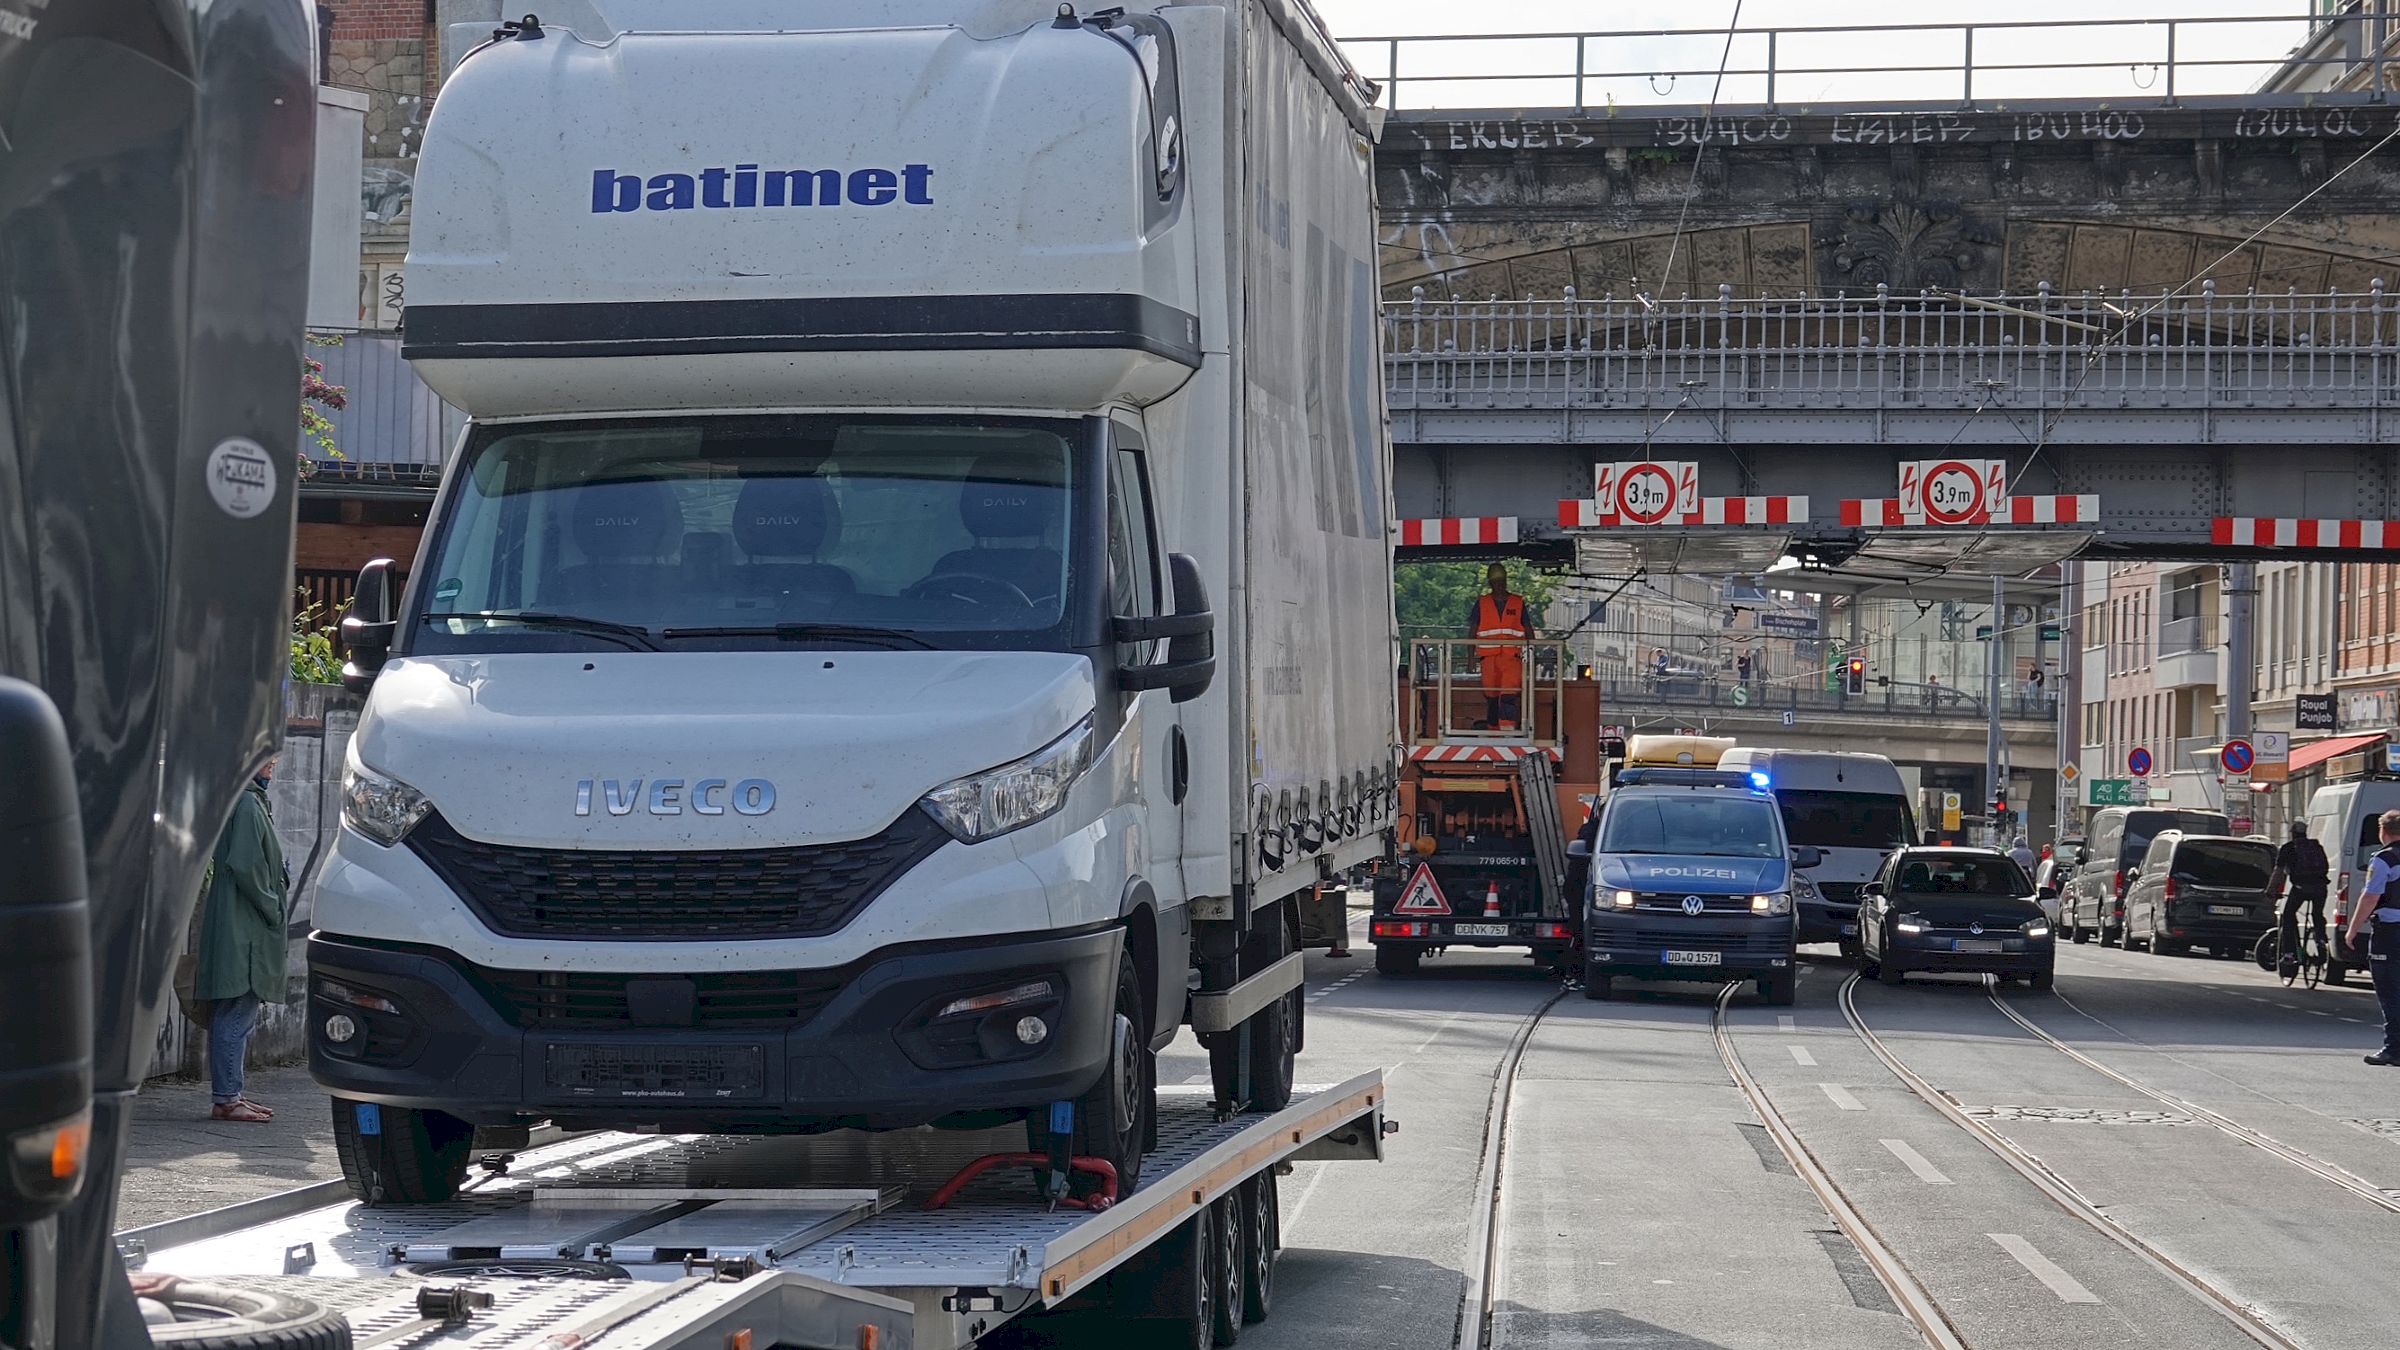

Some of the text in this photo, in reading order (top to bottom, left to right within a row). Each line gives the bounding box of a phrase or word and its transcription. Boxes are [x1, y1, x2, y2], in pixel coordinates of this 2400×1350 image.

[592, 164, 934, 213] batimet
[984, 497, 1028, 506] DAILY
[595, 517, 640, 527] DAILY
[756, 516, 800, 526] DAILY
[1734, 687, 1747, 706] S
[2300, 699, 2328, 712] Royal
[2300, 712, 2333, 724] Punjab
[575, 778, 777, 816] IVECO
[1479, 857, 1495, 865] 779
[1650, 867, 1736, 879] POLIZEI
